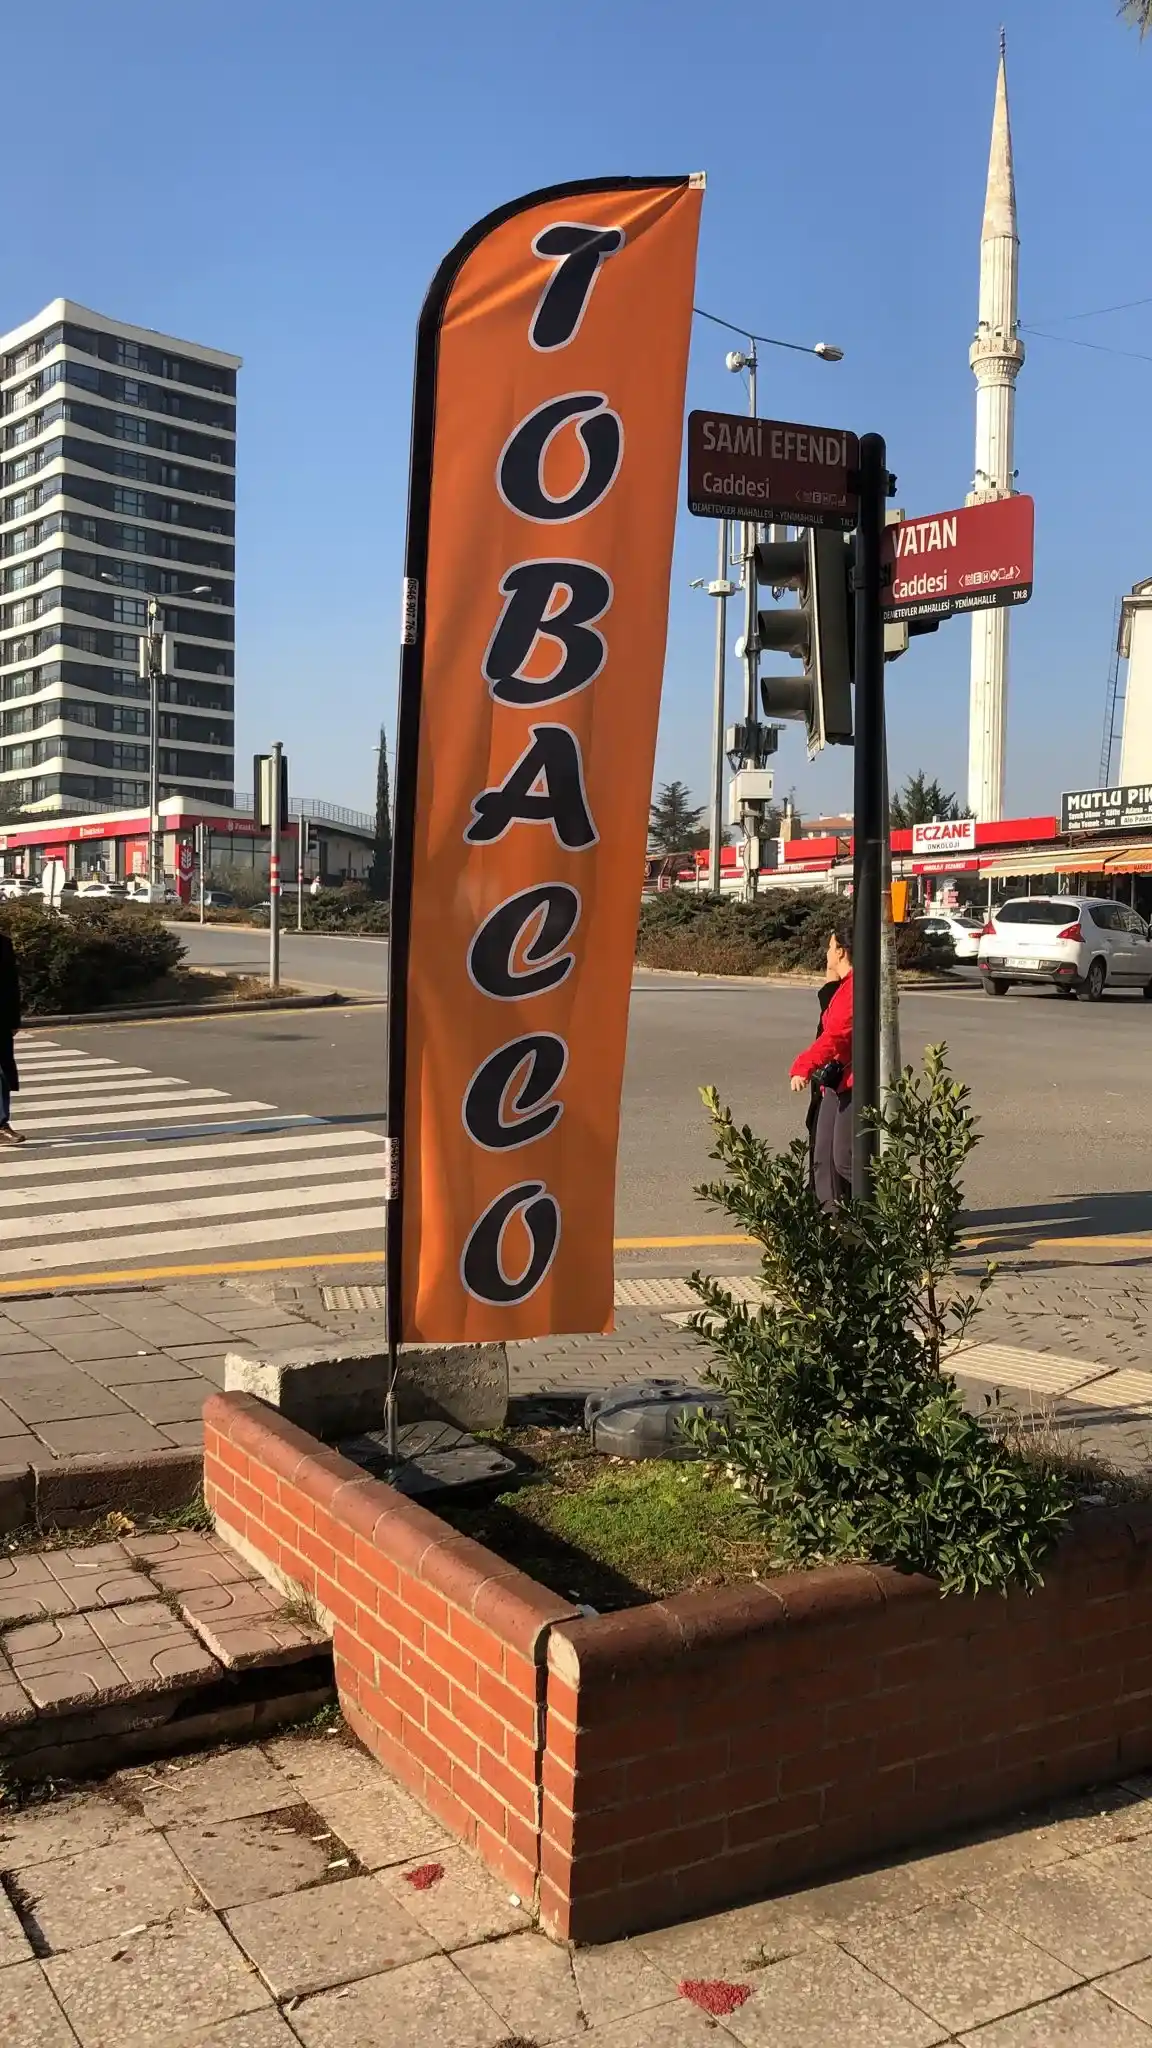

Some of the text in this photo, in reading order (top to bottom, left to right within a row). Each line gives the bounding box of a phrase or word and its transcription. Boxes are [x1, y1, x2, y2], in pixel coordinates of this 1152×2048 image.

[703, 420, 847, 467] SAMİ EFENDİ
[702, 472, 770, 499] Caddesi
[892, 516, 957, 558] VATAN
[892, 569, 948, 599] Caddesi
[883, 607, 918, 620] DEMETEVLER
[918, 599, 950, 615] MAHALLESİ
[954, 593, 997, 609] YENİMAHALLE
[461, 221, 627, 1307] TOBACCO
[1067, 790, 1122, 811] MUTLU
[915, 823, 971, 842] ECZANE
